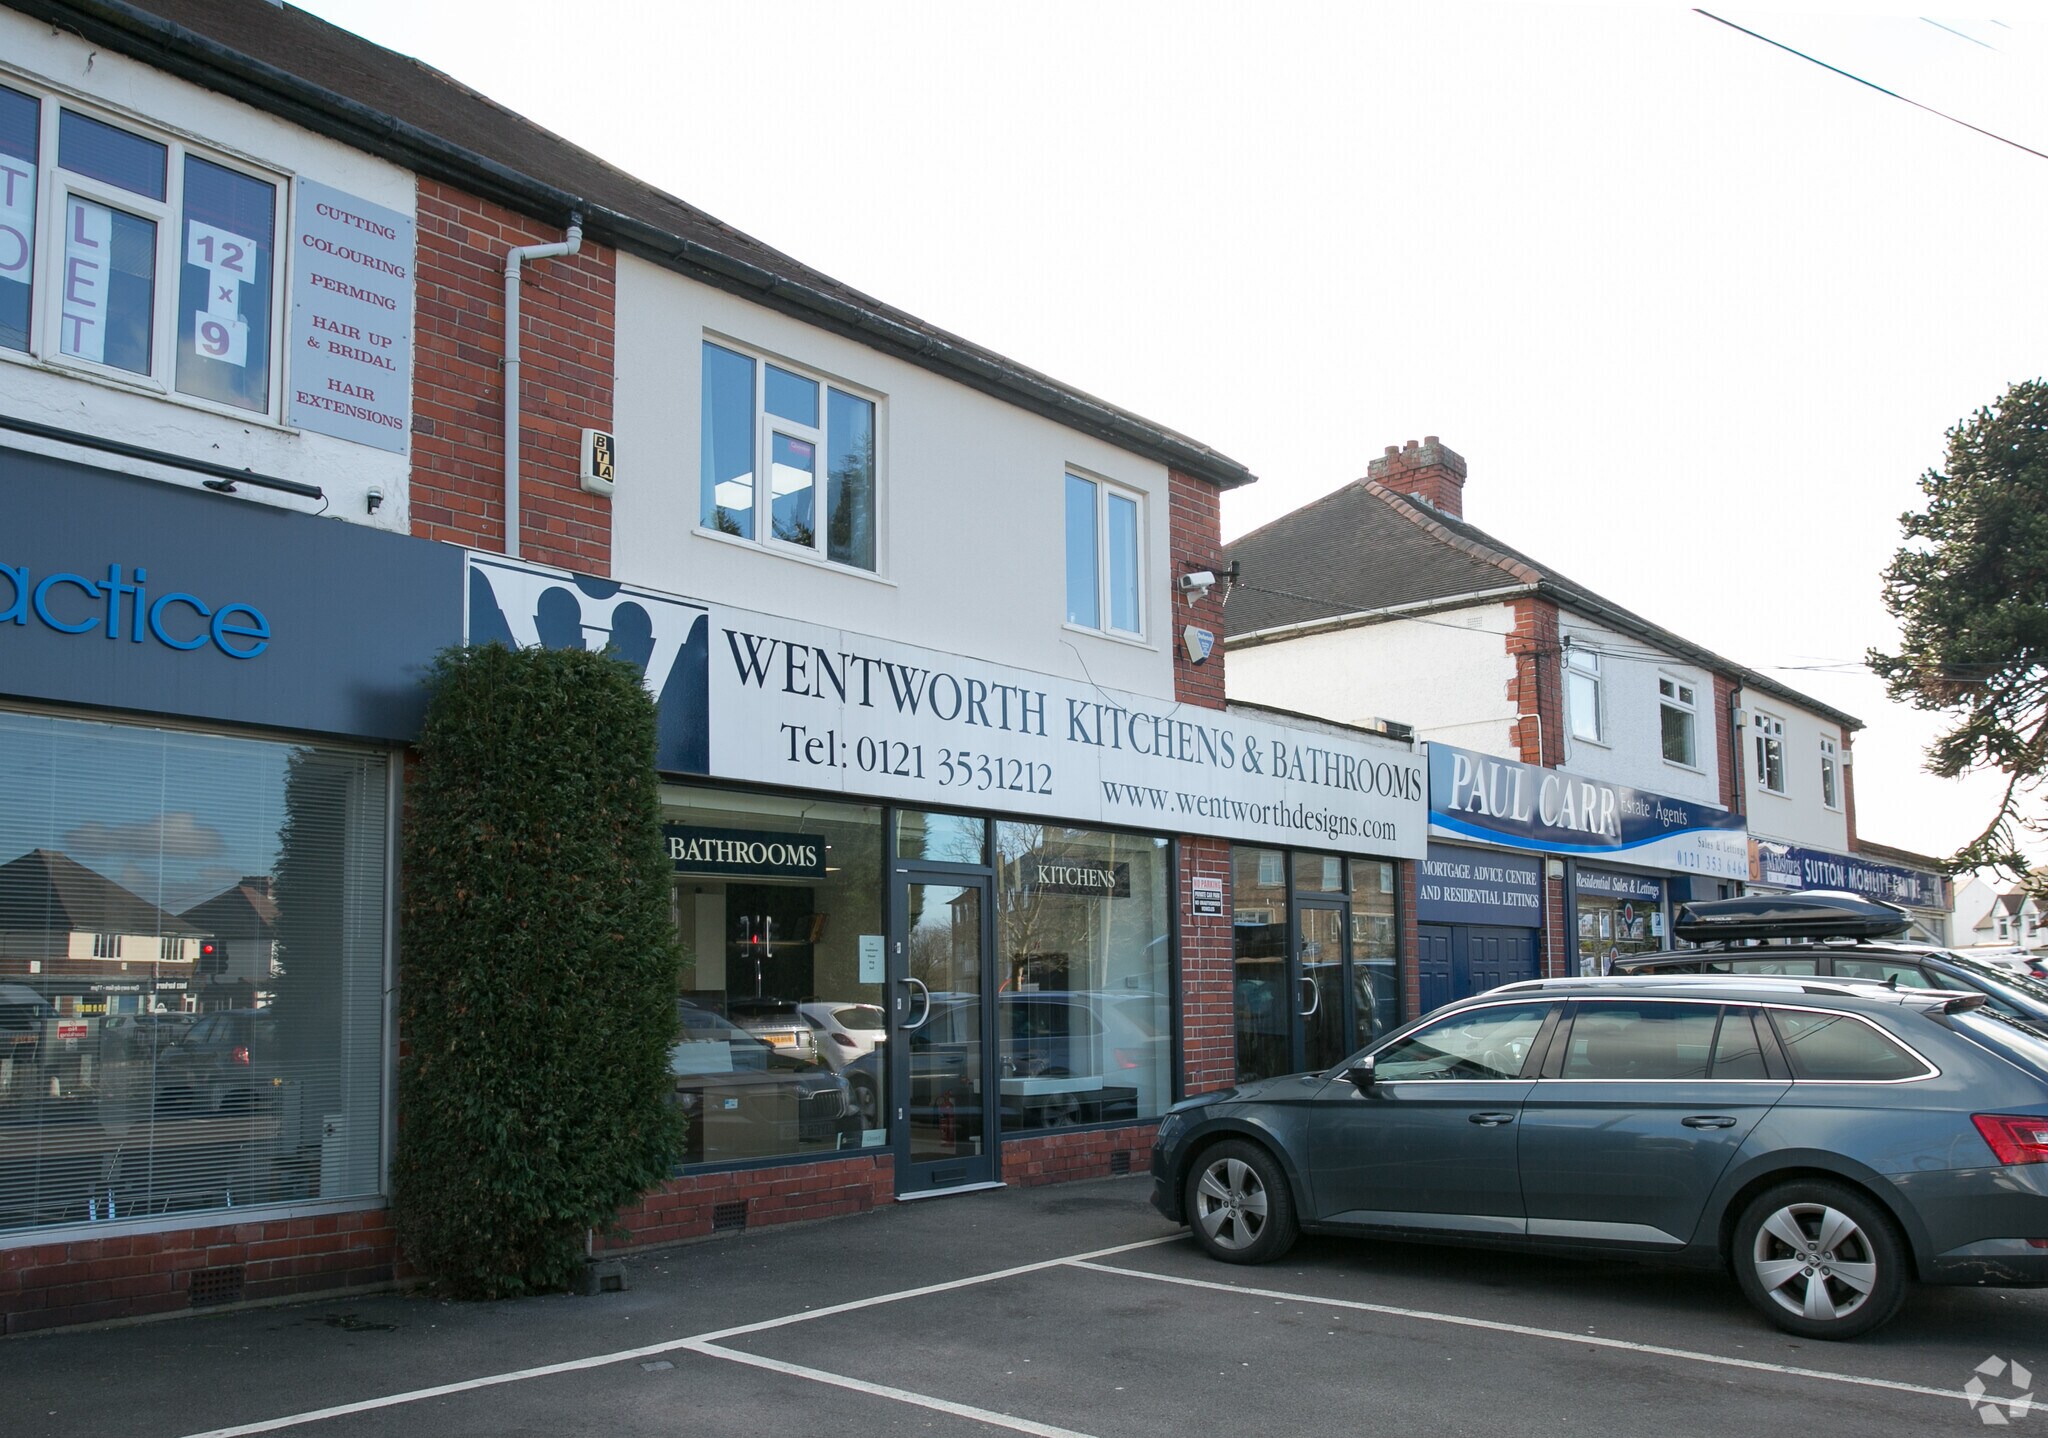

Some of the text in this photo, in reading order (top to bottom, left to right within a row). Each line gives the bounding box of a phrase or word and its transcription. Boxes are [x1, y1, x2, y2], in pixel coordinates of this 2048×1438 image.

[316, 203, 396, 241] CUTTING
[302, 234, 406, 279] COLOURING
[62, 205, 99, 353] LET
[218, 286, 233, 303] x
[310, 272, 397, 311] PERMING
[312, 315, 393, 349] HAIR UP
[307, 335, 396, 372] & BRIDAL
[327, 378, 375, 402] HAIR
[296, 390, 403, 430] EXTENSIONS
[721, 628, 1422, 802] WENTWORTH KITCHENS & BATHROOMS
[780, 722, 1053, 796] Tel: 0121 3531212
[1101, 779, 1397, 842] www.wentworthdesigns.com
[1447, 753, 1688, 837] PAUL CARR Estate Agents
[669, 836, 817, 867] BATHROOMS
[1677, 850, 1700, 869] 0121
[1706, 855, 1722, 872] 353
[1698, 836, 1714, 851] Sales
[1723, 842, 1747, 859] Lettings
[1037, 864, 1116, 888] KITCHENS
[1421, 860, 1537, 886] MORTGAGE ADVICE CENTRE
[1576, 872, 1660, 899] Residential Sales & Lettings
[1804, 858, 1845, 888] SUTTON
[1848, 866, 1890, 894] MOBILITY
[1420, 885, 1539, 908] AND RESIDENTIAL LETTINGS
